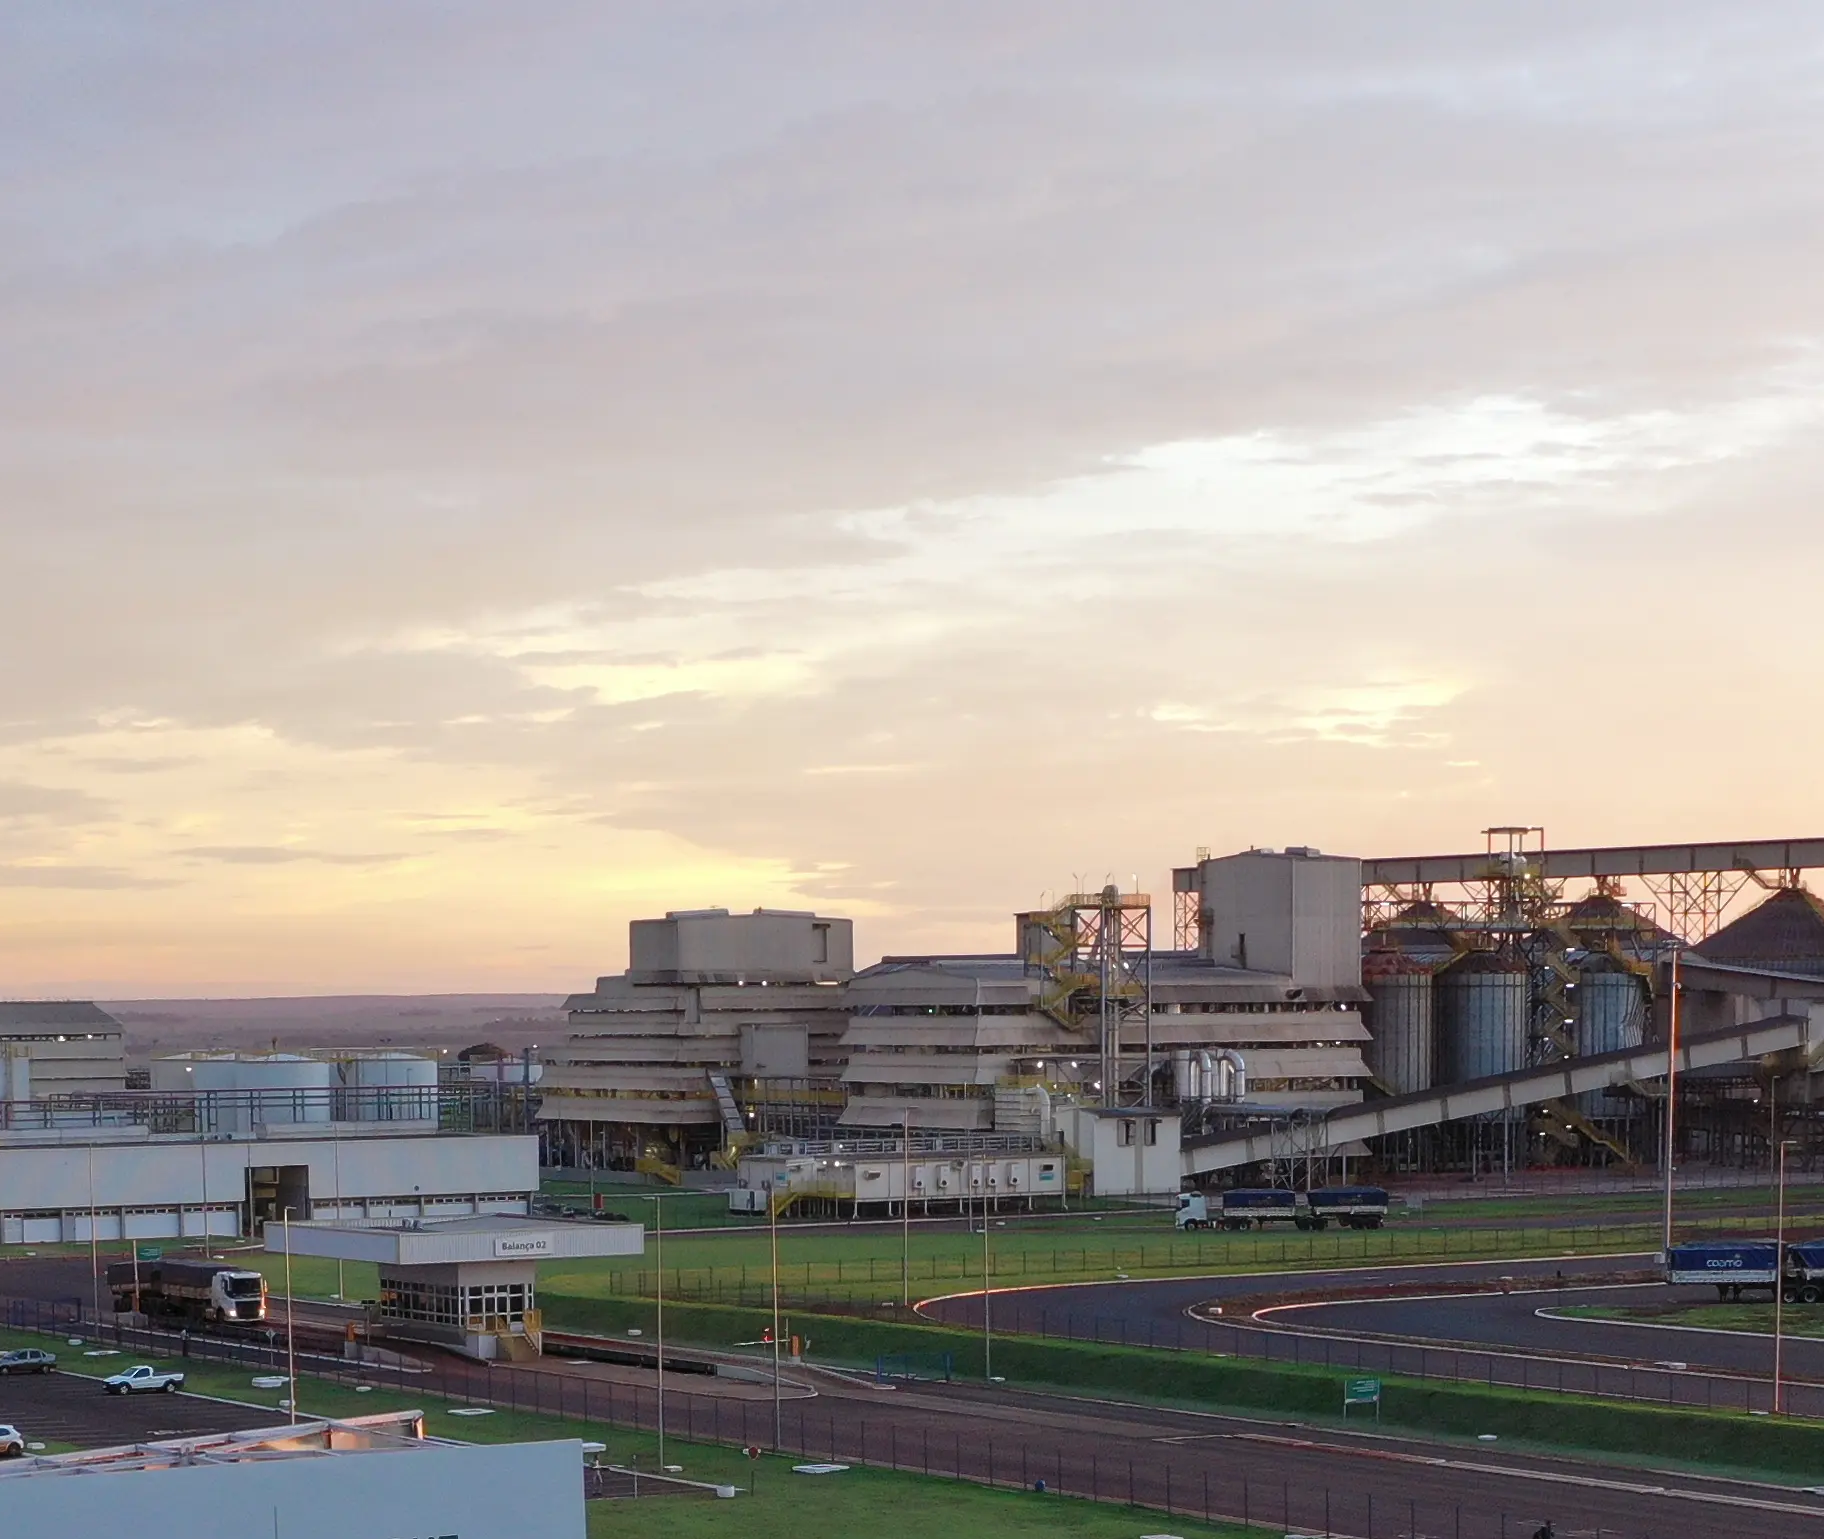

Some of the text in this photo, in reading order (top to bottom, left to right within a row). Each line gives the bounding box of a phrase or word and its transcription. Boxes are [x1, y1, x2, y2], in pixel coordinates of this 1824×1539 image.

[502, 1241, 547, 1252] Balança 02
[1706, 1258, 1743, 1268] coamo
